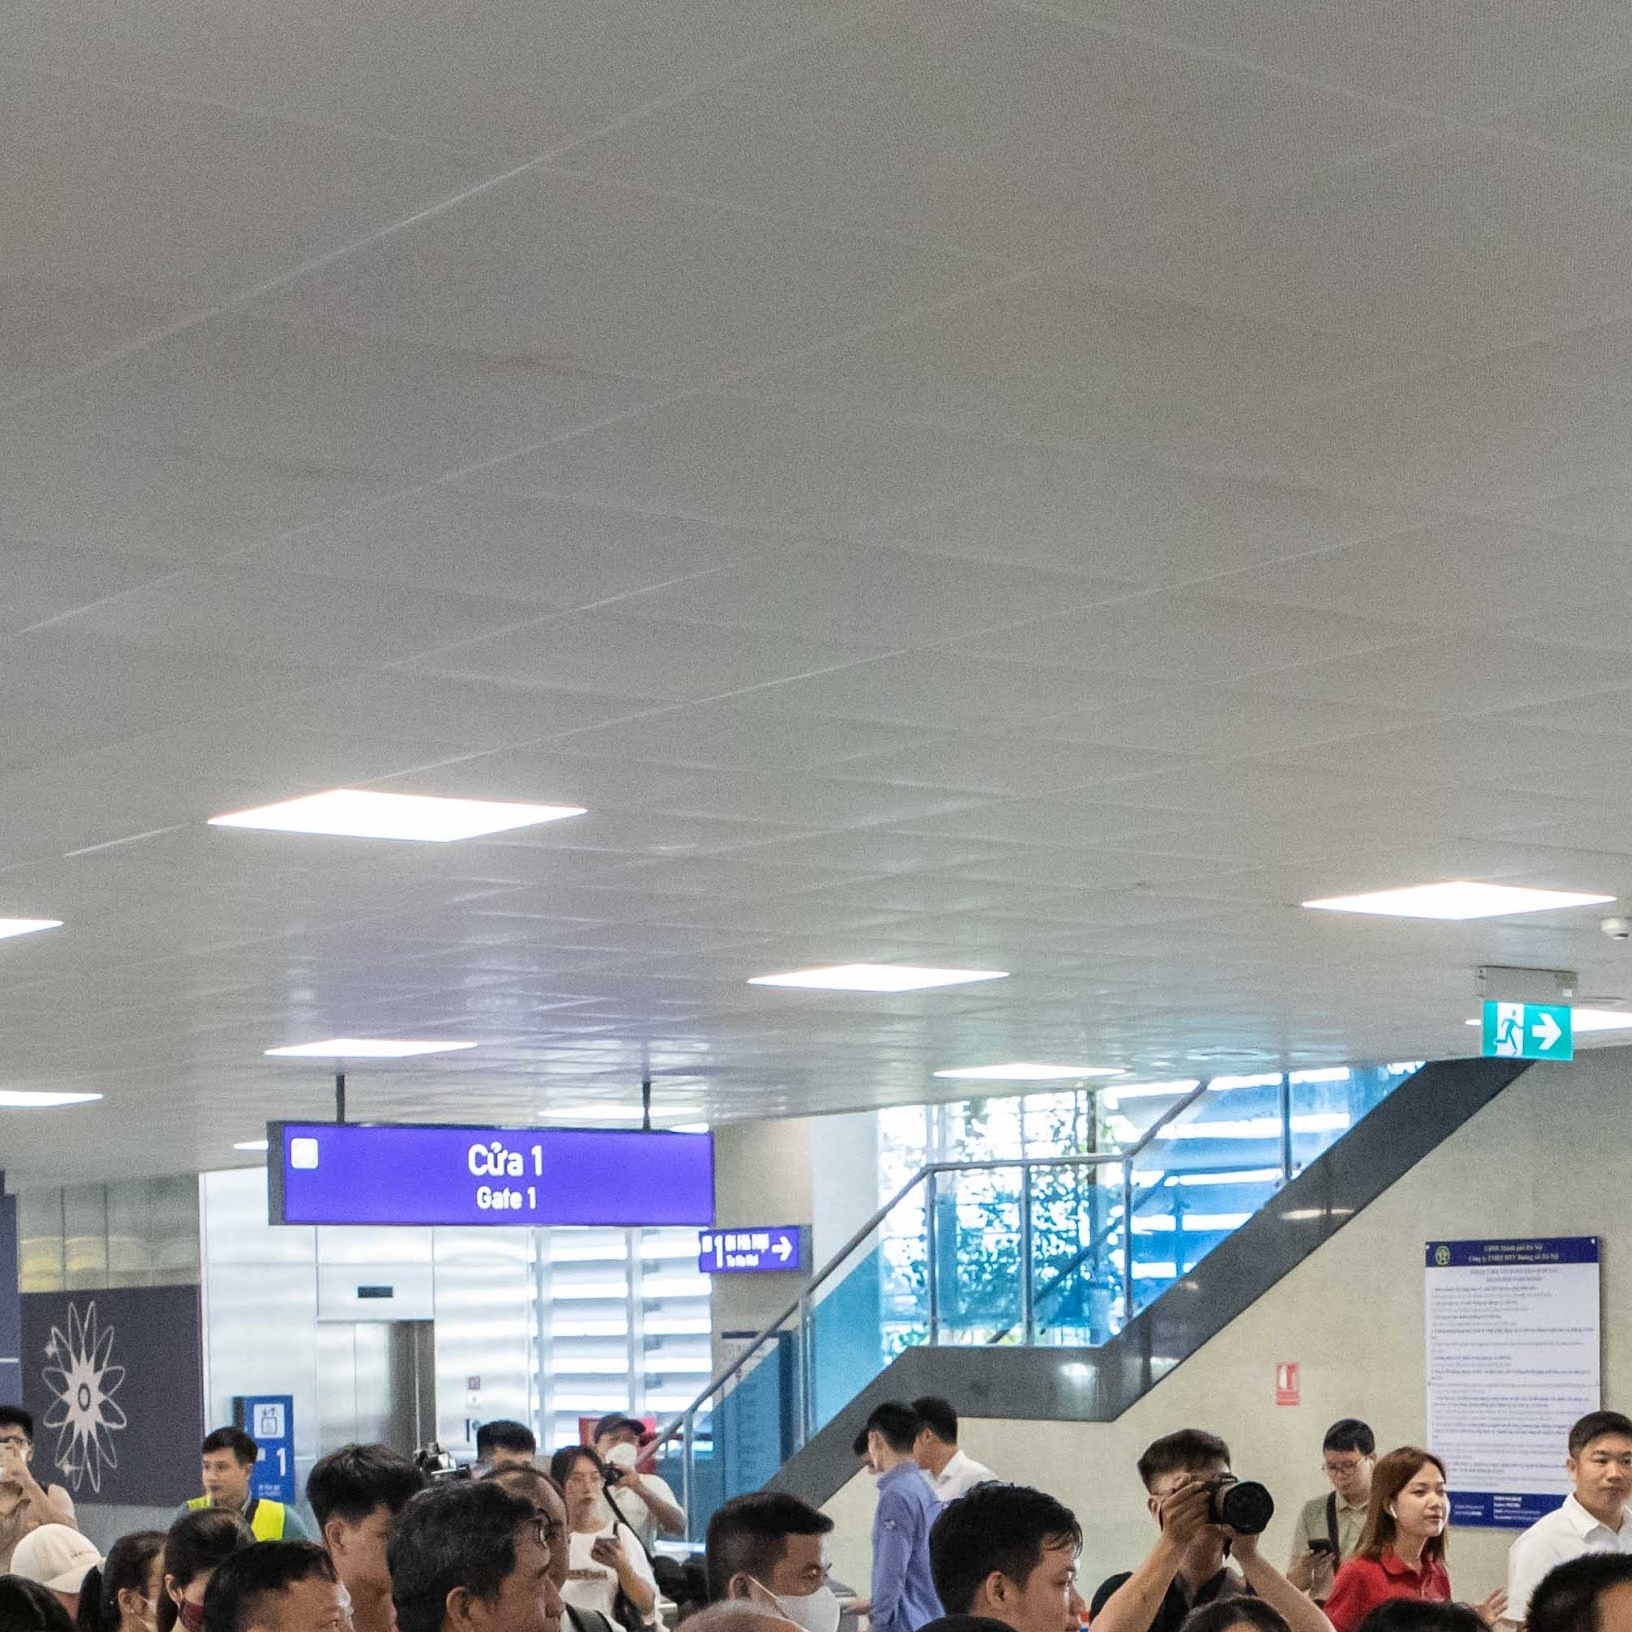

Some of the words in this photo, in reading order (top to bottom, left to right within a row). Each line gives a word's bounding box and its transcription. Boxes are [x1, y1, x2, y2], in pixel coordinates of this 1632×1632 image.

[468, 1142, 524, 1176] Cửa
[531, 1145, 542, 1176] 1
[477, 1186, 523, 1209] Gate
[528, 1187, 537, 1209] 1
[276, 1447, 286, 1477] 1
